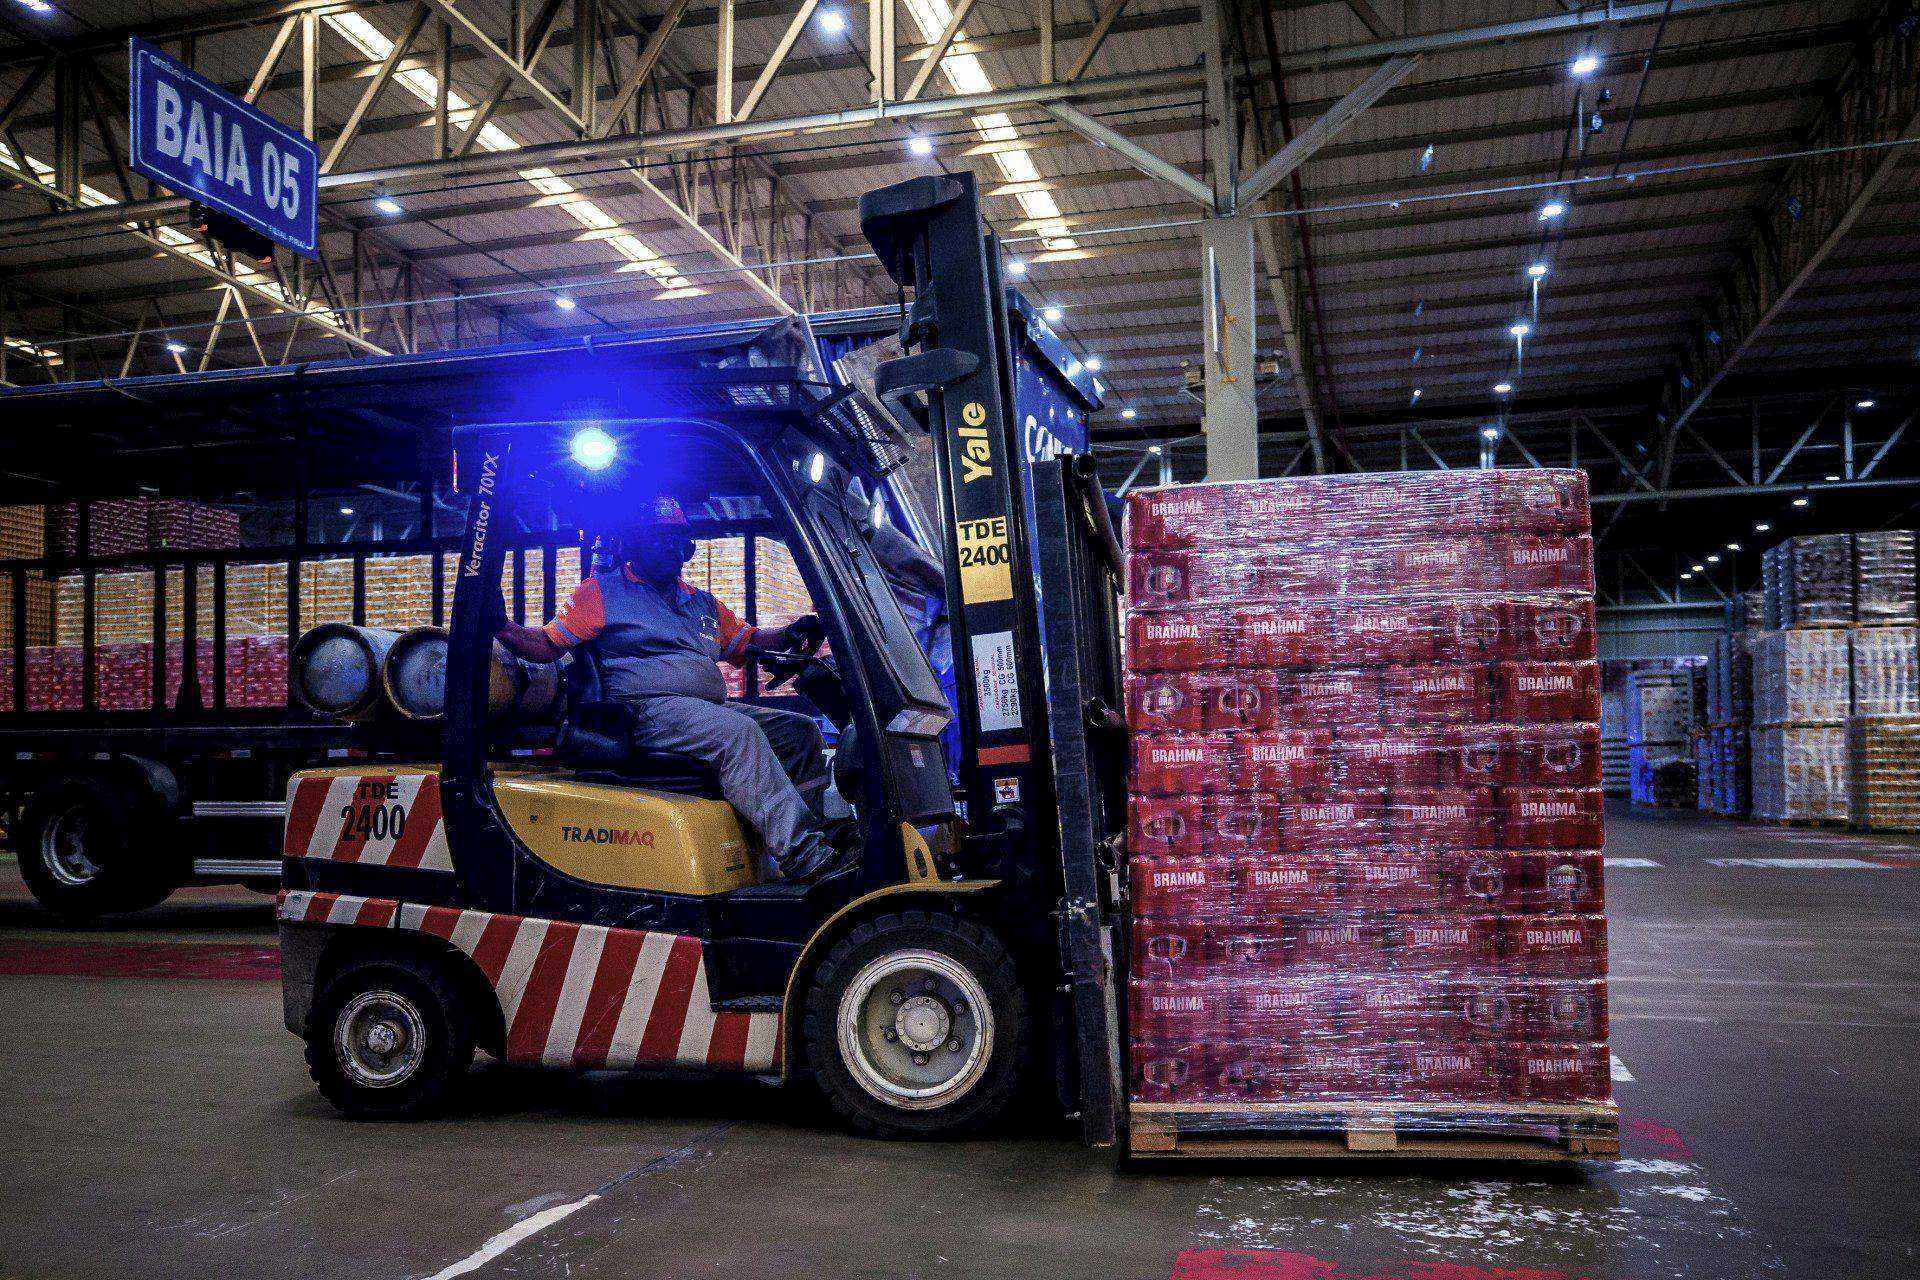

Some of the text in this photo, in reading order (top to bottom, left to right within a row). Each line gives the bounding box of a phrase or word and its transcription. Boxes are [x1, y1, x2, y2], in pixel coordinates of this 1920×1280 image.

[156, 80, 300, 220] BAIA 05
[957, 401, 993, 484] Yale
[465, 451, 500, 577] Veracitor 70VX
[959, 519, 1006, 541] TDE
[960, 543, 1011, 568] 2400
[1513, 548, 1568, 565] BRAHMA
[1147, 624, 1200, 639] BRAHMA
[1253, 619, 1306, 635] BRAHMA
[998, 673, 1006, 685] CG
[1007, 672, 1015, 685] CG
[1412, 677, 1467, 693] BRAHMA
[1519, 675, 1574, 692] BRAHMA
[1152, 749, 1204, 764] BRAHMA
[1253, 744, 1305, 761] BRAHMA
[355, 781, 399, 800] TDE
[1301, 804, 1355, 821] BRAHMA
[1412, 805, 1467, 820] BRAHMA
[1521, 802, 1576, 818] BRAHMA
[341, 804, 406, 842] 2400
[562, 825, 655, 848] TRADIMAQ
[1153, 871, 1206, 888] BRAHMA
[1255, 869, 1309, 885] BRAHMA
[1365, 866, 1418, 882] BRAHMA
[1307, 928, 1360, 944] BRAHMA
[1414, 929, 1469, 945] BRAHMA
[1526, 930, 1582, 945] BRAHMA
[1152, 996, 1204, 1011] BRAHMA
[1256, 993, 1309, 1010] BRAHMA
[1416, 1055, 1472, 1072] BRAHMA
[1529, 1058, 1583, 1075] BRAHMA
